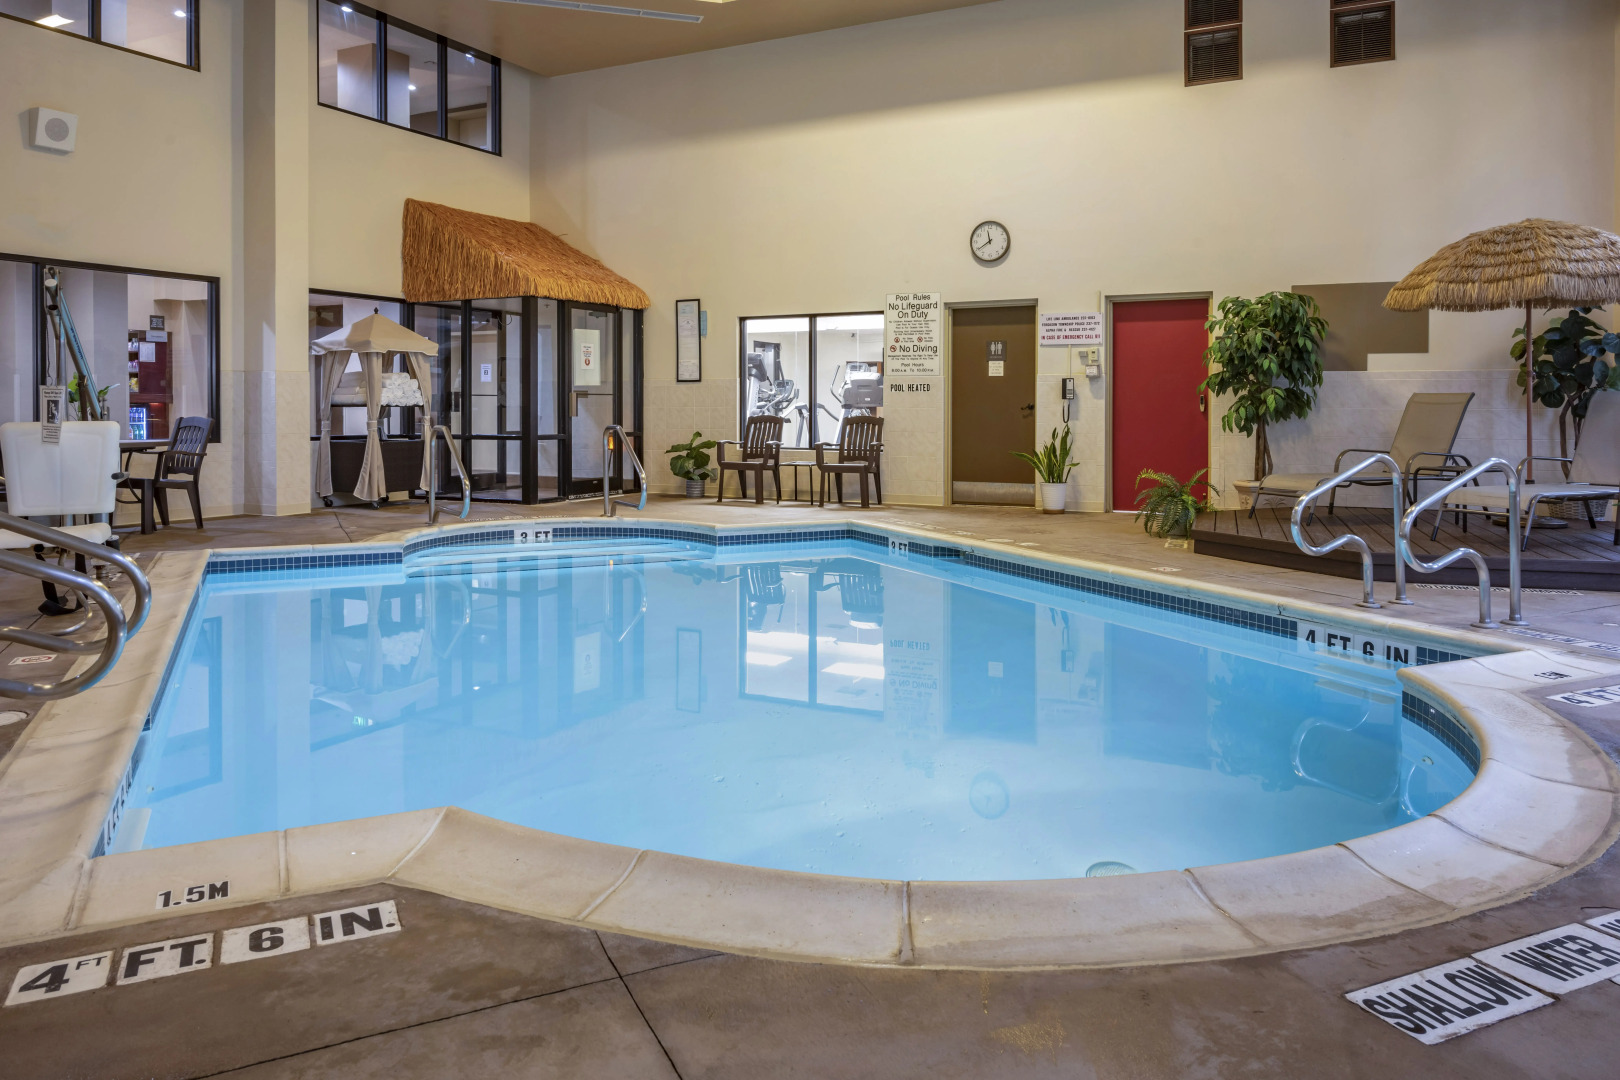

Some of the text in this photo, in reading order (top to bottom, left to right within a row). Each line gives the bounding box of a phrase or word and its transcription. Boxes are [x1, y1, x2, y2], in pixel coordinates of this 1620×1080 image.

[902, 301, 937, 311] Lifeguard
[911, 310, 928, 319] Duty
[913, 345, 937, 353] Diving
[890, 384, 930, 392] POOL HEATED
[1306, 629, 1315, 643] 4
[1362, 641, 1374, 656] 6
[159, 881, 229, 908] 1.5M
[18, 907, 396, 993] 4 FT FT. 6 IN.
[1361, 935, 1620, 1034] SHALLOW WATER
